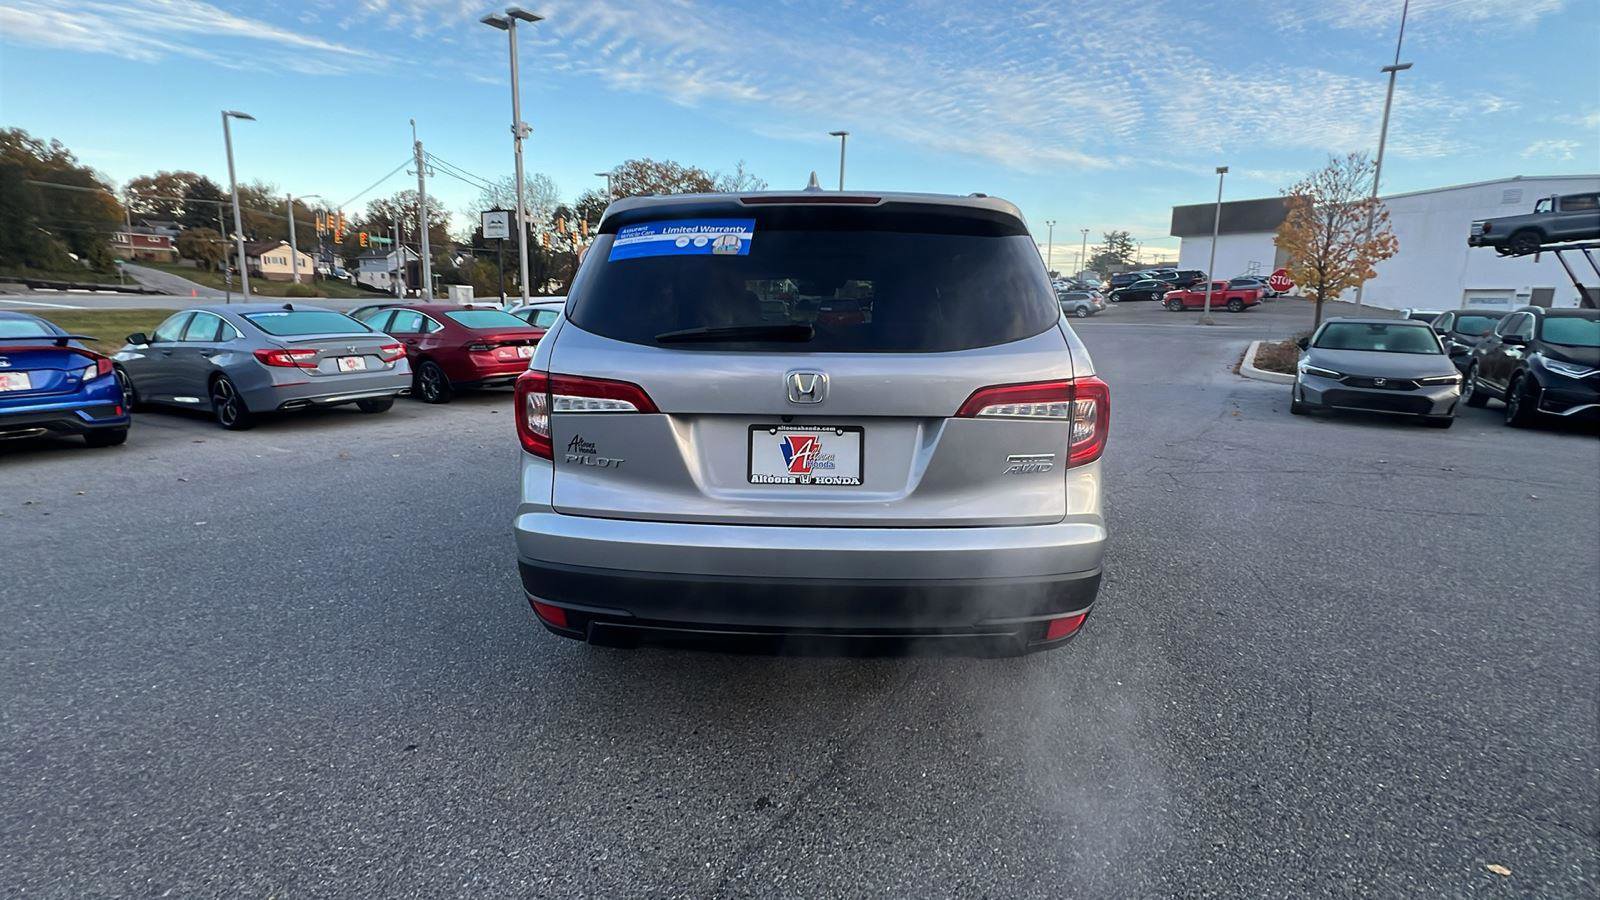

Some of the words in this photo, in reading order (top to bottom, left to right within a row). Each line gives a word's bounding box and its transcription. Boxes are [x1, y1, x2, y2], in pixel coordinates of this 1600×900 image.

[662, 226, 698, 234] Limited
[700, 225, 747, 233] Warranty
[565, 454, 625, 468] PILOT
[807, 460, 835, 469] Honda
[750, 474, 797, 484] Altoona
[815, 476, 861, 485] HONDA
